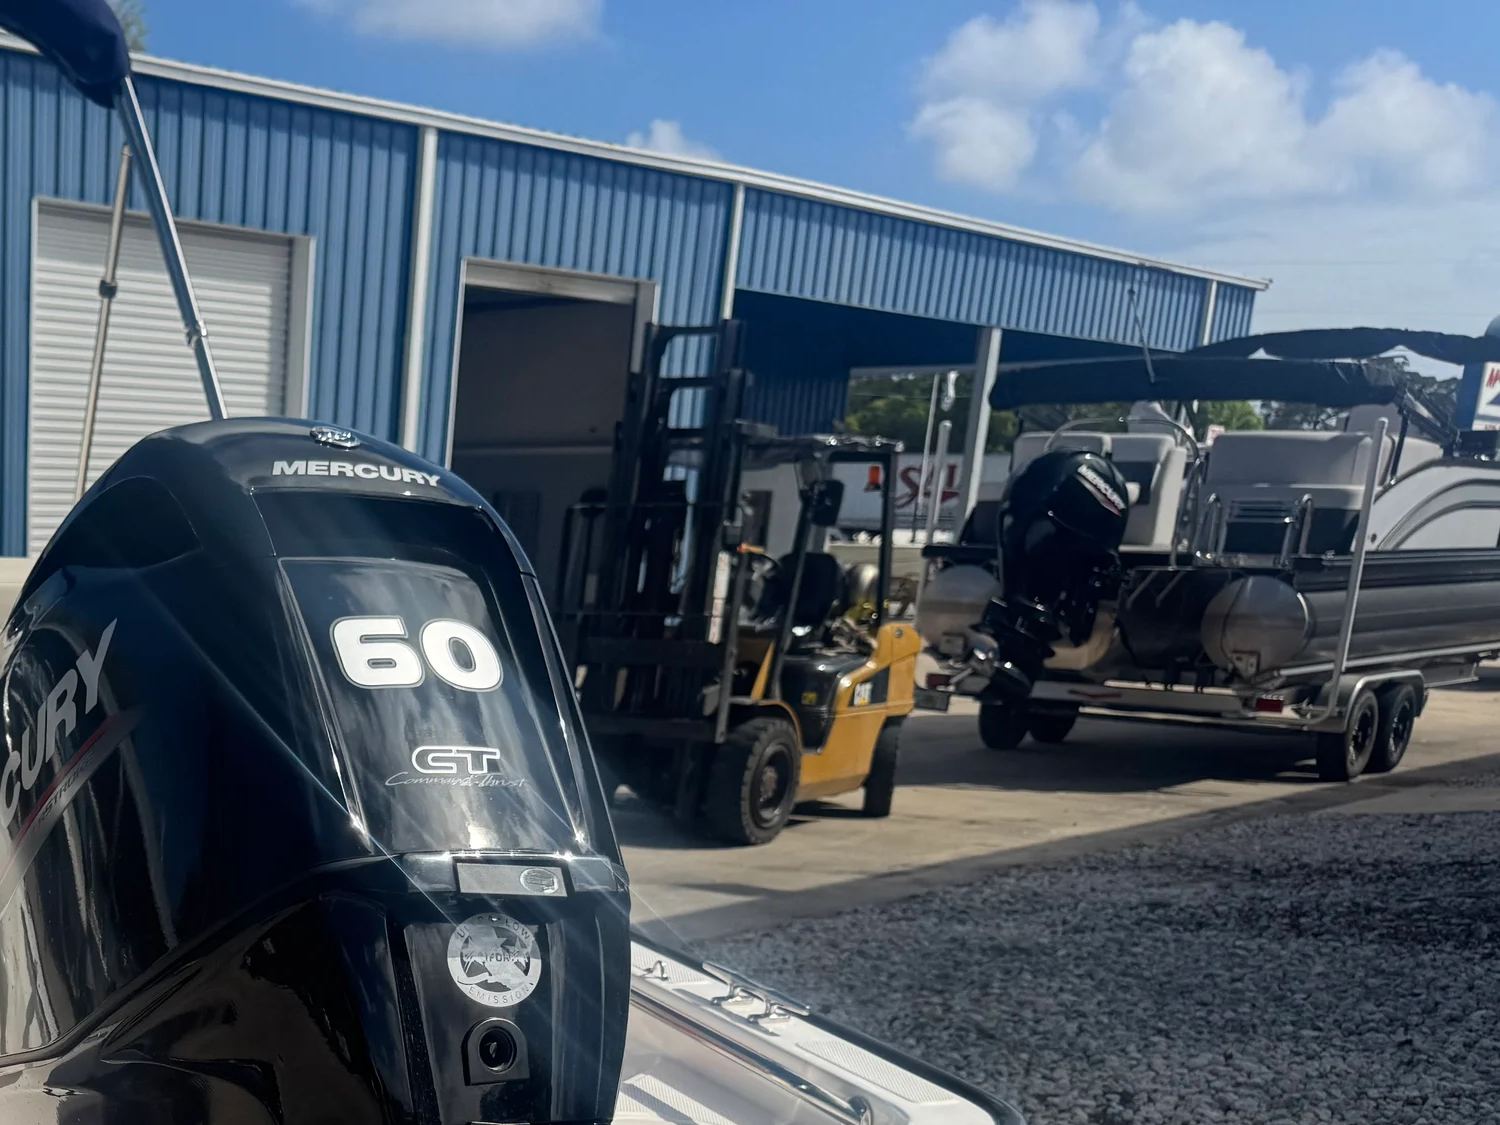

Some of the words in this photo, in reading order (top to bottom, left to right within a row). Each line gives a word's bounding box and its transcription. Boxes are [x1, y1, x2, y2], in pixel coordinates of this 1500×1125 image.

[272, 460, 441, 487] MERCURY
[329, 614, 504, 693] 60
[411, 745, 501, 774] GT
[505, 919, 531, 940] LOW
